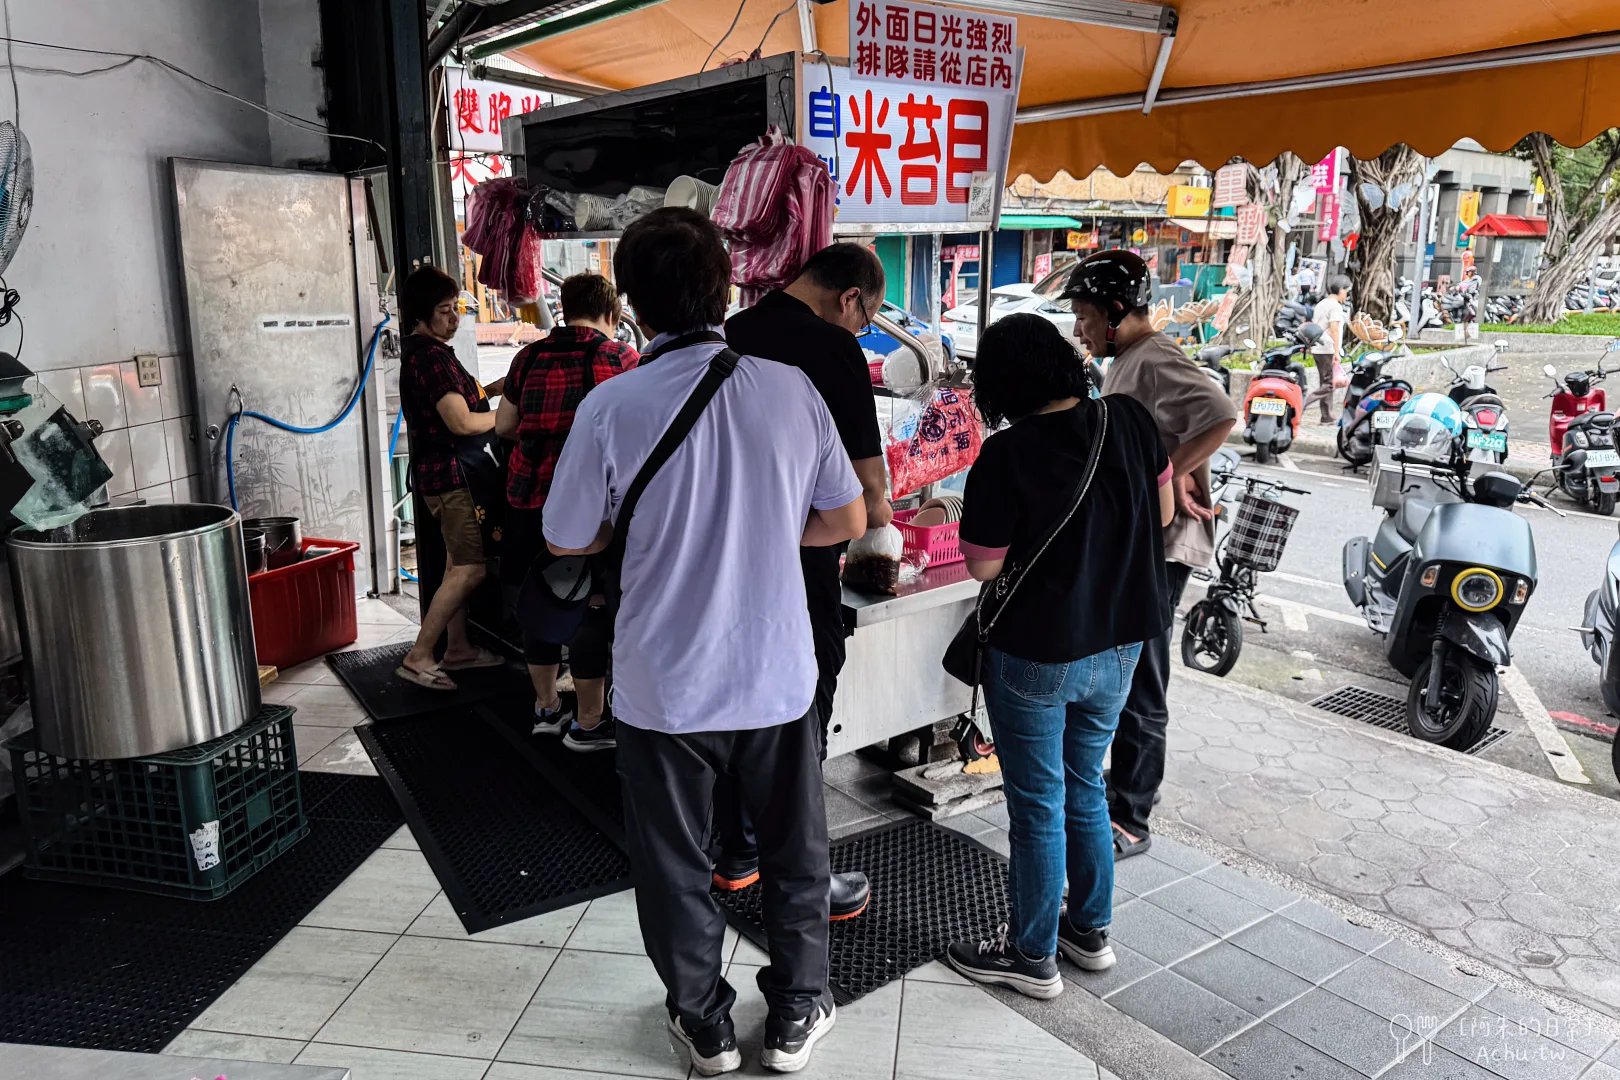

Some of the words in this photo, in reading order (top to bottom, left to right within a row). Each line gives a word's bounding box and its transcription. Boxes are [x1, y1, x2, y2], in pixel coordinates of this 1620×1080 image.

[856, 1, 1012, 54] 外面日光強烈
[856, 40, 1012, 89] 排隊請從店內
[845, 89, 989, 205] 米苔目
